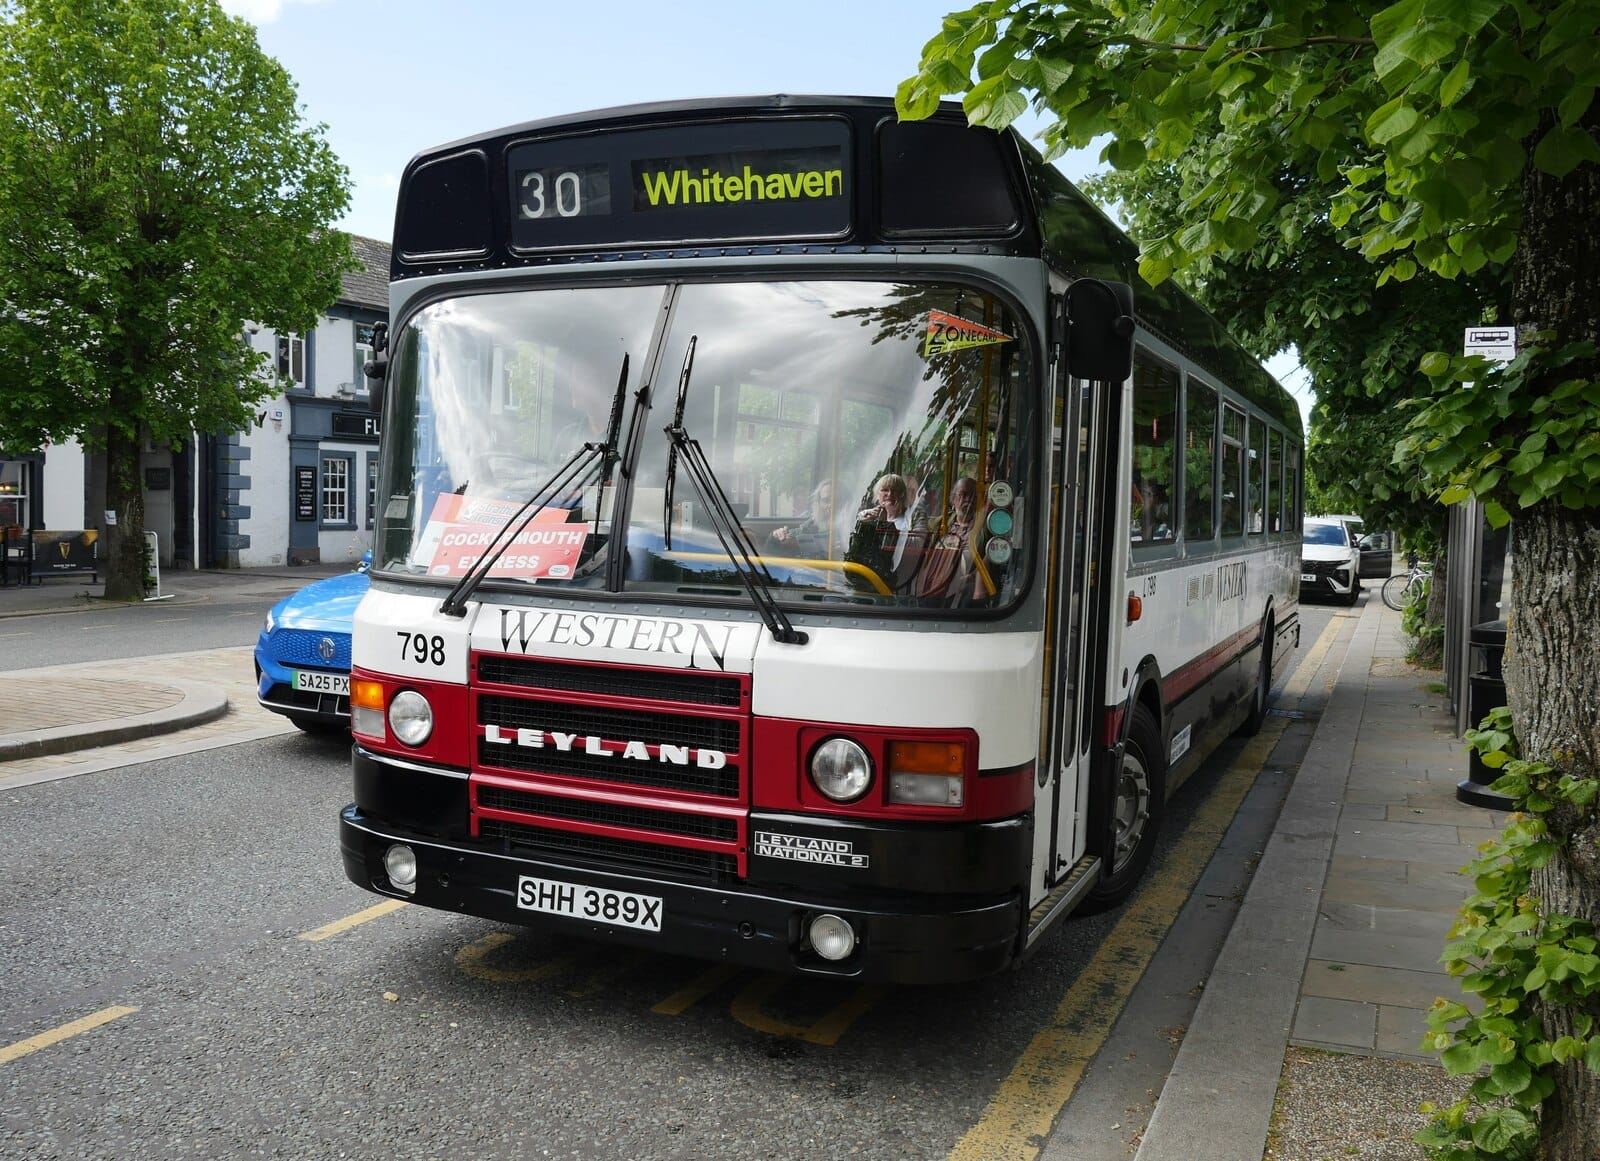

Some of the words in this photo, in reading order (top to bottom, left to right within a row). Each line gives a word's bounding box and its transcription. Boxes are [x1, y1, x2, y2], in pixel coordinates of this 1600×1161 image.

[521, 172, 582, 219] 30
[642, 165, 842, 206] Whitehaven
[928, 321, 998, 345] ZONECARD
[397, 631, 446, 667] 798
[499, 608, 740, 673] WESTERN
[299, 673, 330, 690] SA25
[485, 724, 728, 770] LEYLAND
[759, 845, 846, 865] NATIONAL
[851, 856, 863, 866] 2
[760, 833, 849, 853] LEYLAND
[520, 880, 576, 913] SHH
[583, 890, 660, 928] 389X
